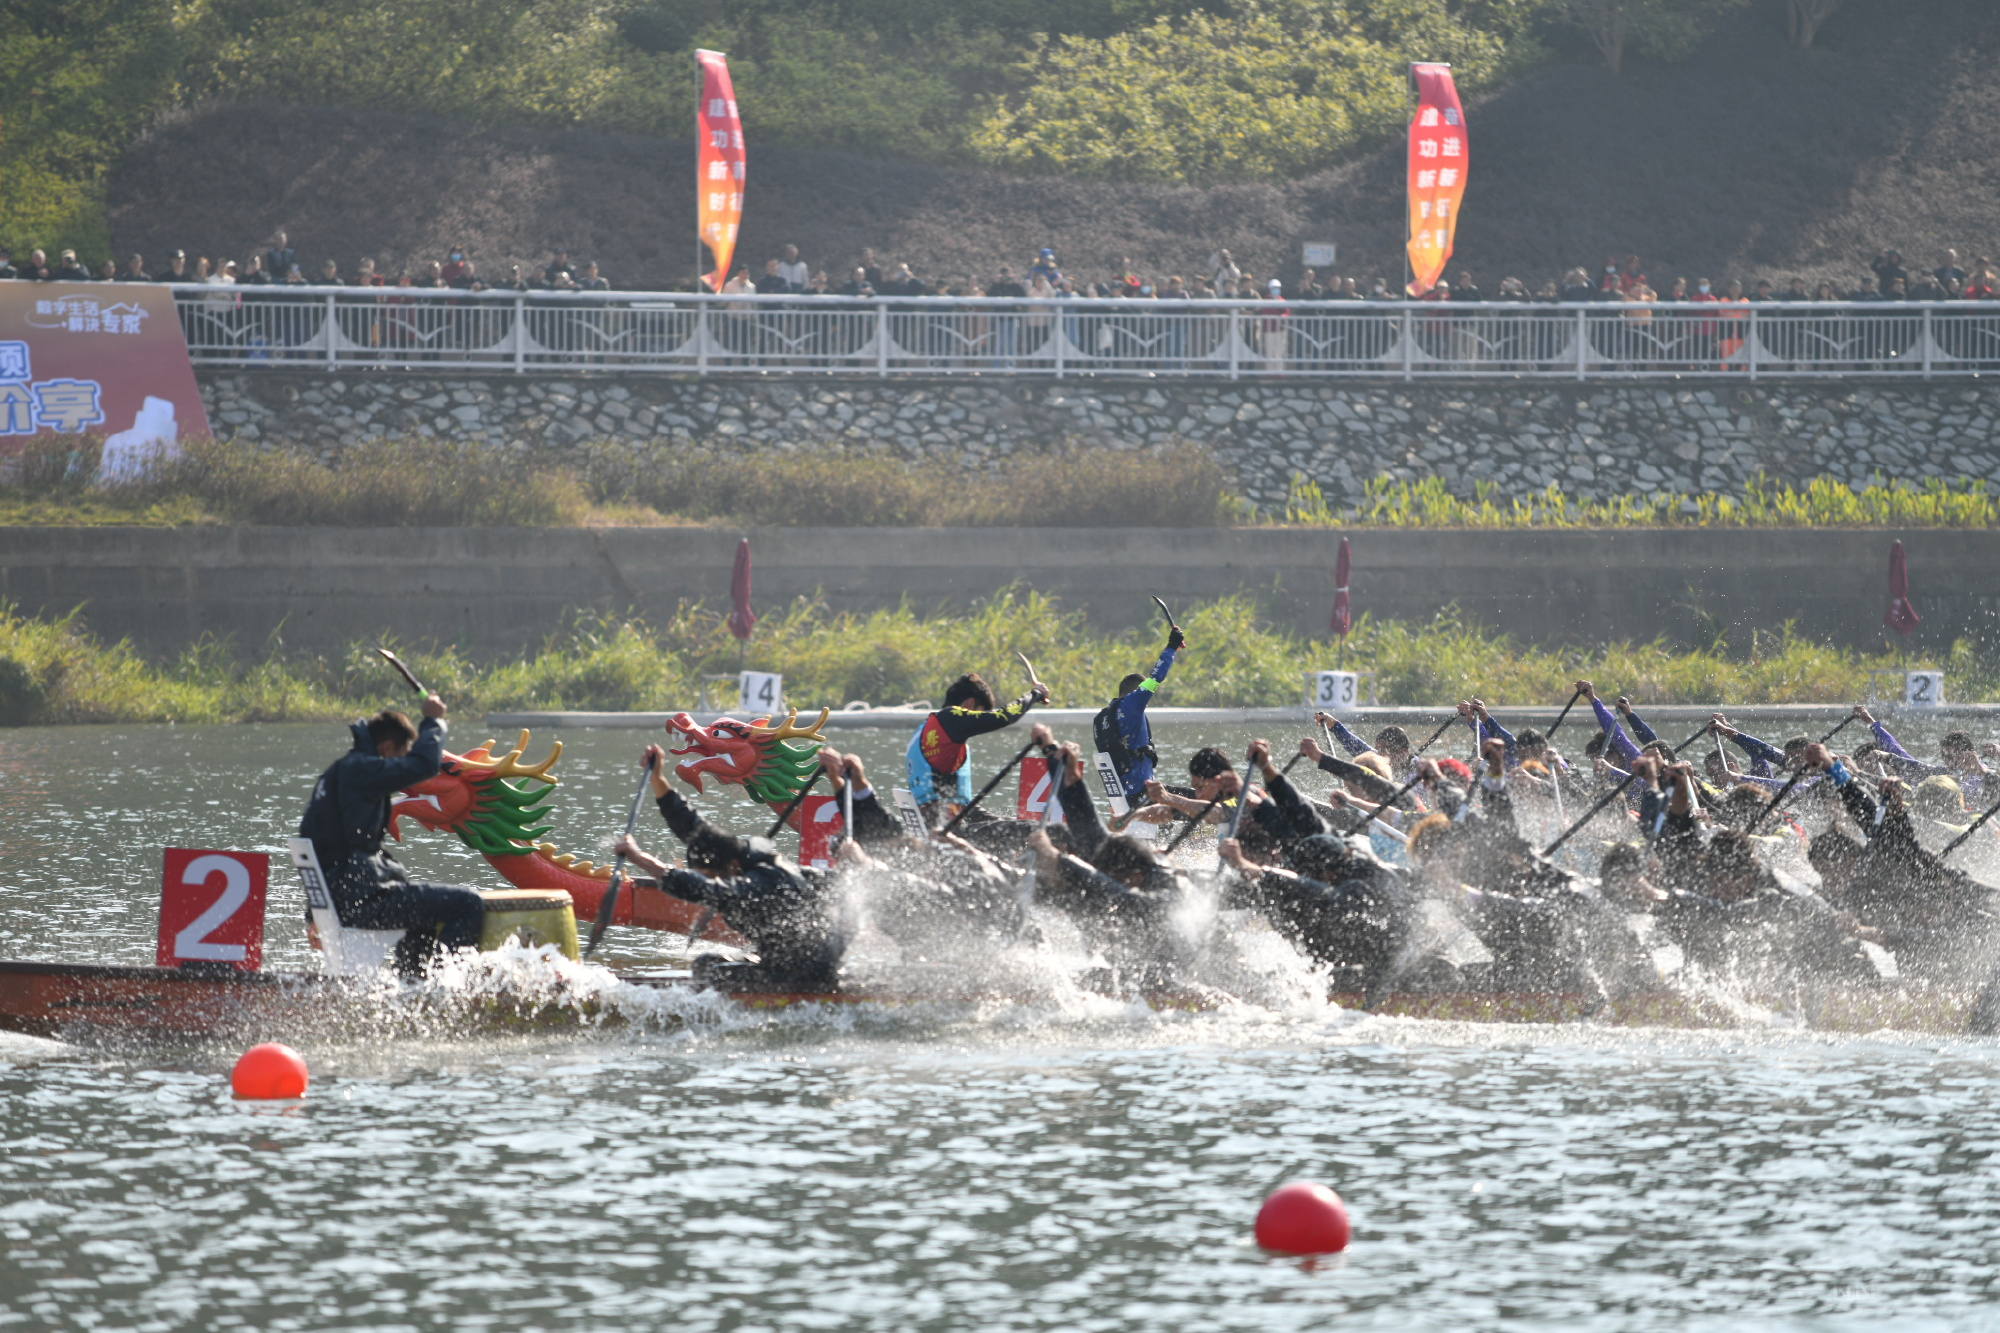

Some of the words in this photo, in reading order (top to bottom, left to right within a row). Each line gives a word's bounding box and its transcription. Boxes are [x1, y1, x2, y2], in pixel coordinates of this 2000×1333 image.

[1912, 675, 1932, 701] 2
[1026, 770, 1065, 824] 4
[174, 853, 250, 961] 2
